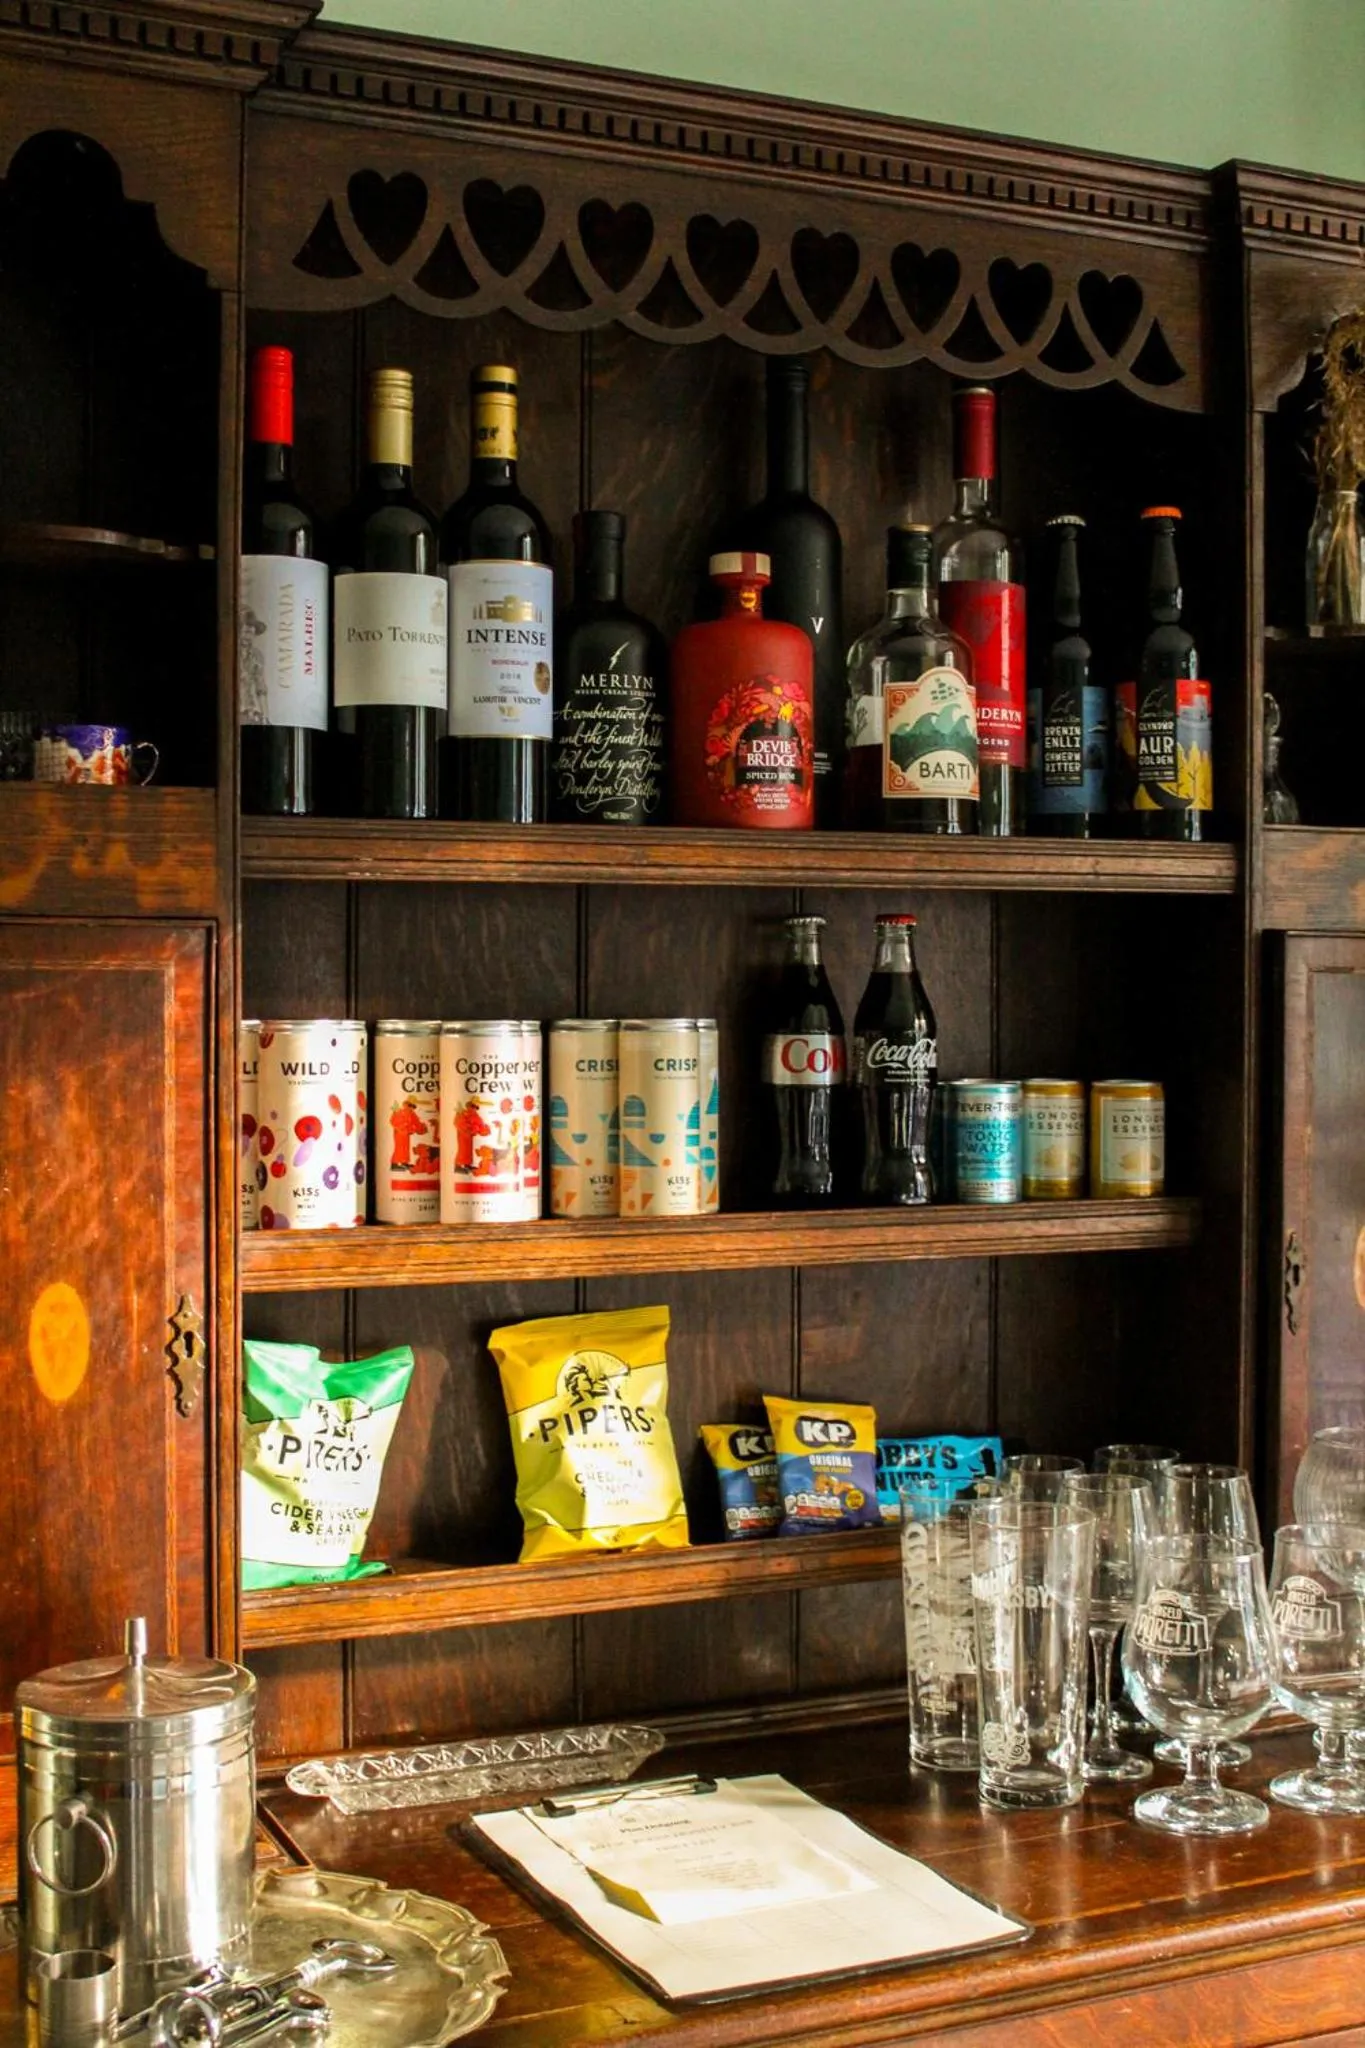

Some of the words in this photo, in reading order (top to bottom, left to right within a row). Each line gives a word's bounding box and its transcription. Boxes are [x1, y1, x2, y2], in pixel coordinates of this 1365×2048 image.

[303, 598, 317, 676] MALBEC
[466, 627, 549, 649] INTENSE
[580, 673, 654, 691] MERLYN
[976, 736, 1010, 749] EGEND
[1044, 736, 1082, 748] ENLLI
[1138, 735, 1175, 755] AUR
[746, 752, 797, 768] BRIDGE
[1138, 755, 1175, 767] GOLDEN
[745, 772, 778, 781] SPICED
[918, 761, 971, 781] BARTI
[280, 1061, 331, 1077] WILD
[391, 1058, 441, 1080] Copp
[454, 1058, 521, 1083] Copper
[653, 1058, 698, 1073] CRISP
[464, 1076, 515, 1095] Crew
[588, 1175, 615, 1186] KISS
[667, 1175, 693, 1187] KISS
[292, 1187, 321, 1198] KISS
[538, 1406, 654, 1443] PIPERS
[800, 1420, 851, 1443] KP
[808, 1454, 854, 1468] ORIGINAL
[270, 1502, 323, 1522] CIDER
[289, 1520, 301, 1534] &
[1274, 1600, 1333, 1634] PORETTI
[1137, 1614, 1199, 1647] PORETTI
